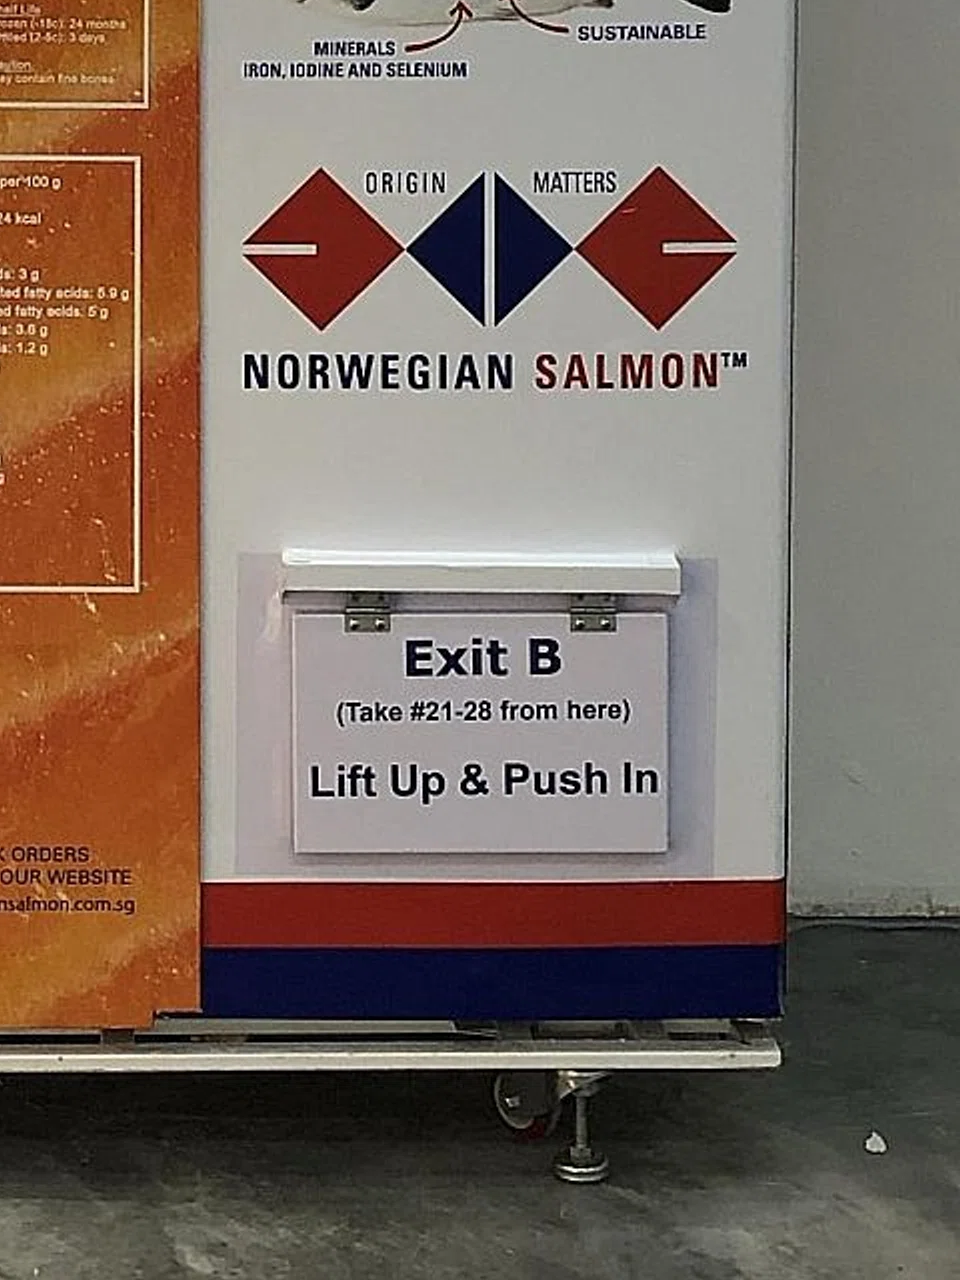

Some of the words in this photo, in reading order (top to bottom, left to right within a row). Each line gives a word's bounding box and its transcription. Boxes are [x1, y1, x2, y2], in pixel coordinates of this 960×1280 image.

[578, 25, 706, 41] SUSTAINABLE
[314, 41, 395, 56] MINERALS
[244, 63, 287, 79] IRON,
[290, 63, 345, 78] IODINE
[348, 63, 382, 77] AND
[386, 63, 468, 77] SELENIUM
[0, 178, 22, 189] per
[26, 177, 48, 187] 100
[52, 179, 60, 190] g
[365, 171, 445, 194] ORIGIN
[534, 171, 616, 193] MATTERS
[243, 354, 514, 389] NORWEGIAN
[406, 639, 508, 677] Exit
[529, 638, 562, 675] B
[336, 701, 402, 726] (Take
[410, 701, 491, 721] #21-28
[500, 700, 557, 720] from
[567, 699, 631, 723] here)
[311, 764, 377, 797] Lift
[391, 764, 445, 804] Up
[460, 763, 488, 795] &
[504, 763, 608, 795] Push
[624, 762, 658, 794] In
[12, 847, 89, 861] ORDERS
[0, 870, 41, 884] OUR
[48, 871, 132, 885] WEBSITE
